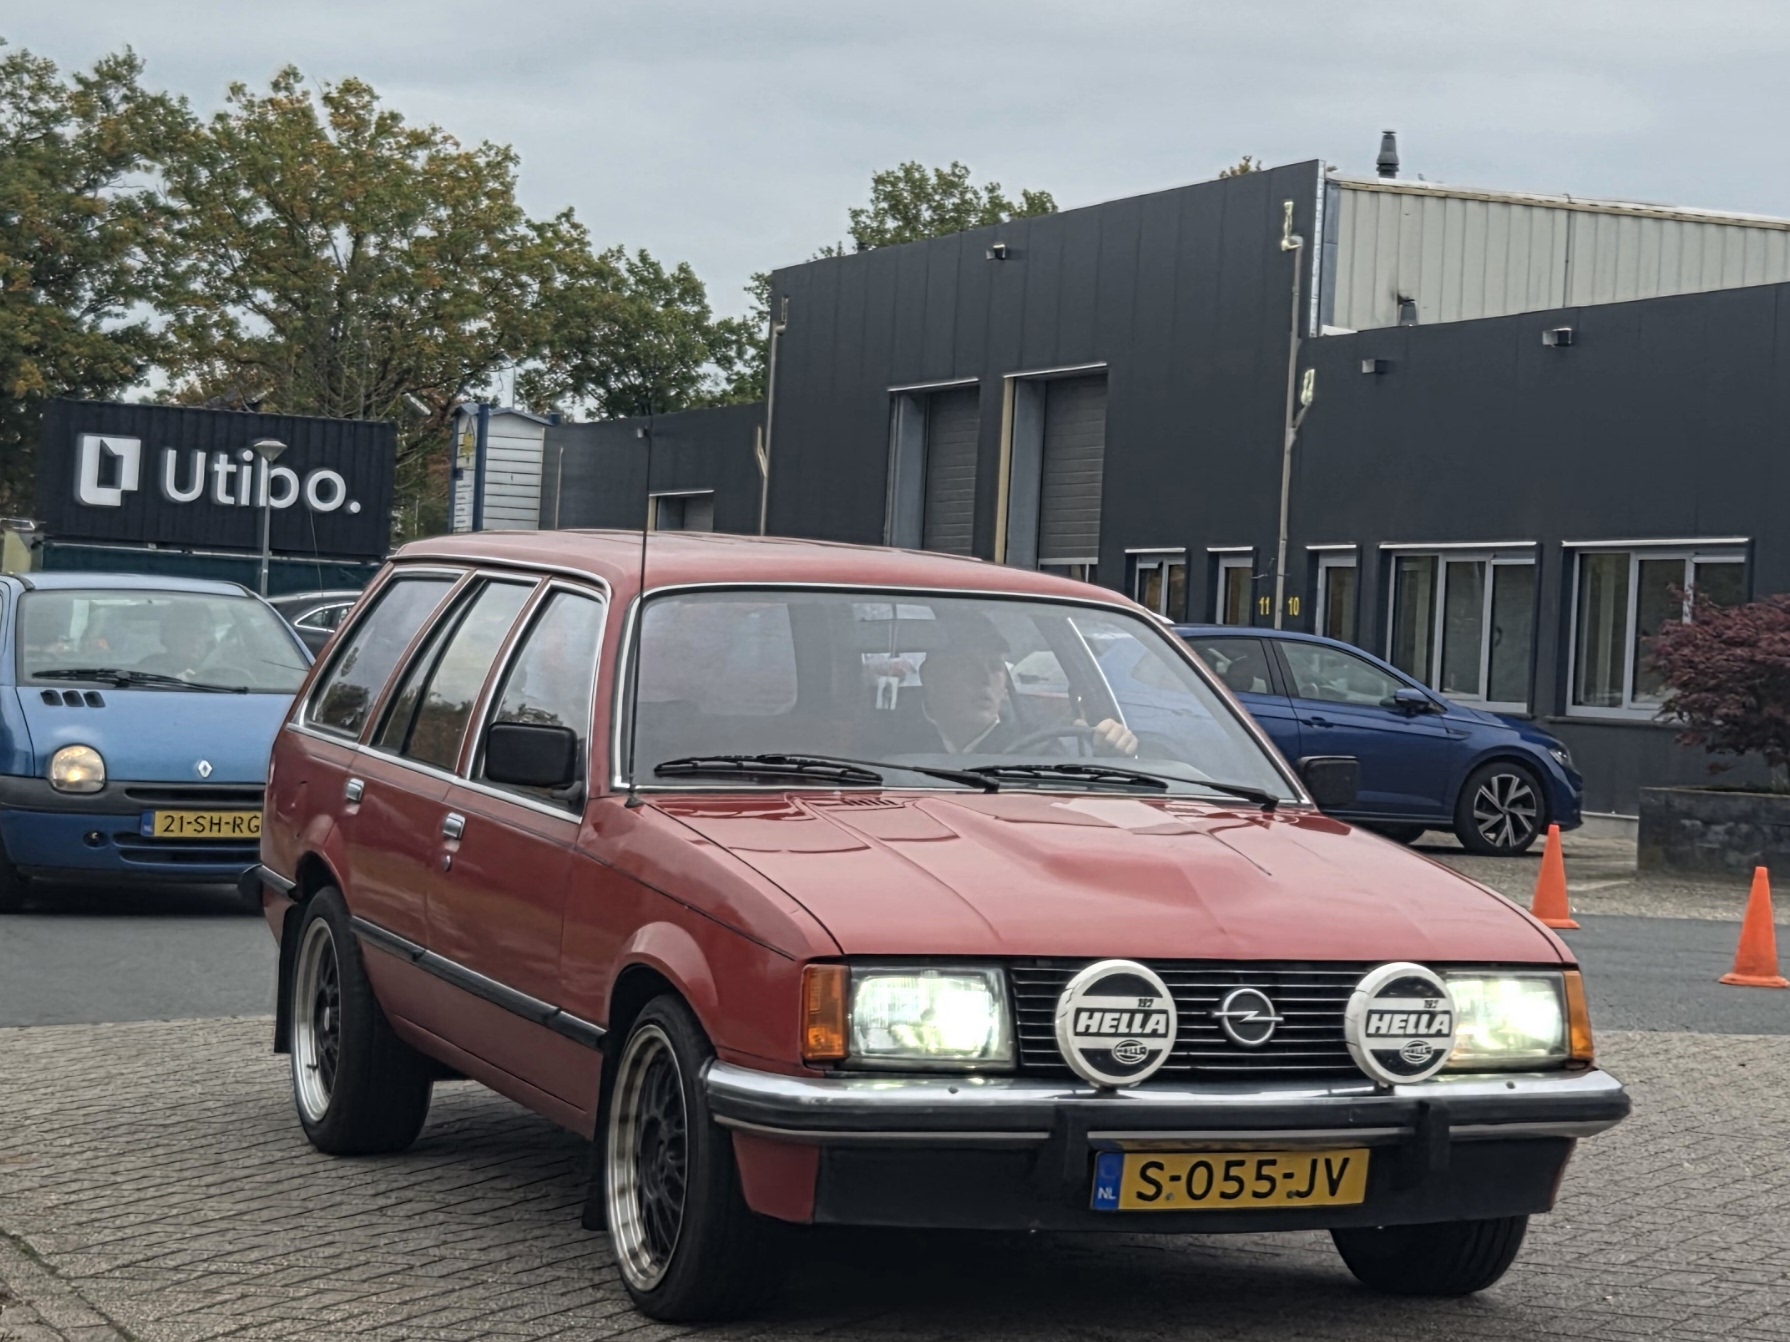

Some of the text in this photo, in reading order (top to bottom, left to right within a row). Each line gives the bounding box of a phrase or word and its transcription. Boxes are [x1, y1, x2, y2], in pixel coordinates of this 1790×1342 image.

[164, 449, 361, 514] Utibo.
[1259, 597, 1270, 615] 11
[1288, 597, 1300, 616] 10
[163, 815, 260, 833] 21-SH-RG
[1075, 1011, 1167, 1034] HELLA
[1367, 1013, 1450, 1035] HELLA
[1136, 1157, 1349, 1202] S-055-JV
[1097, 1187, 1117, 1200] NL
